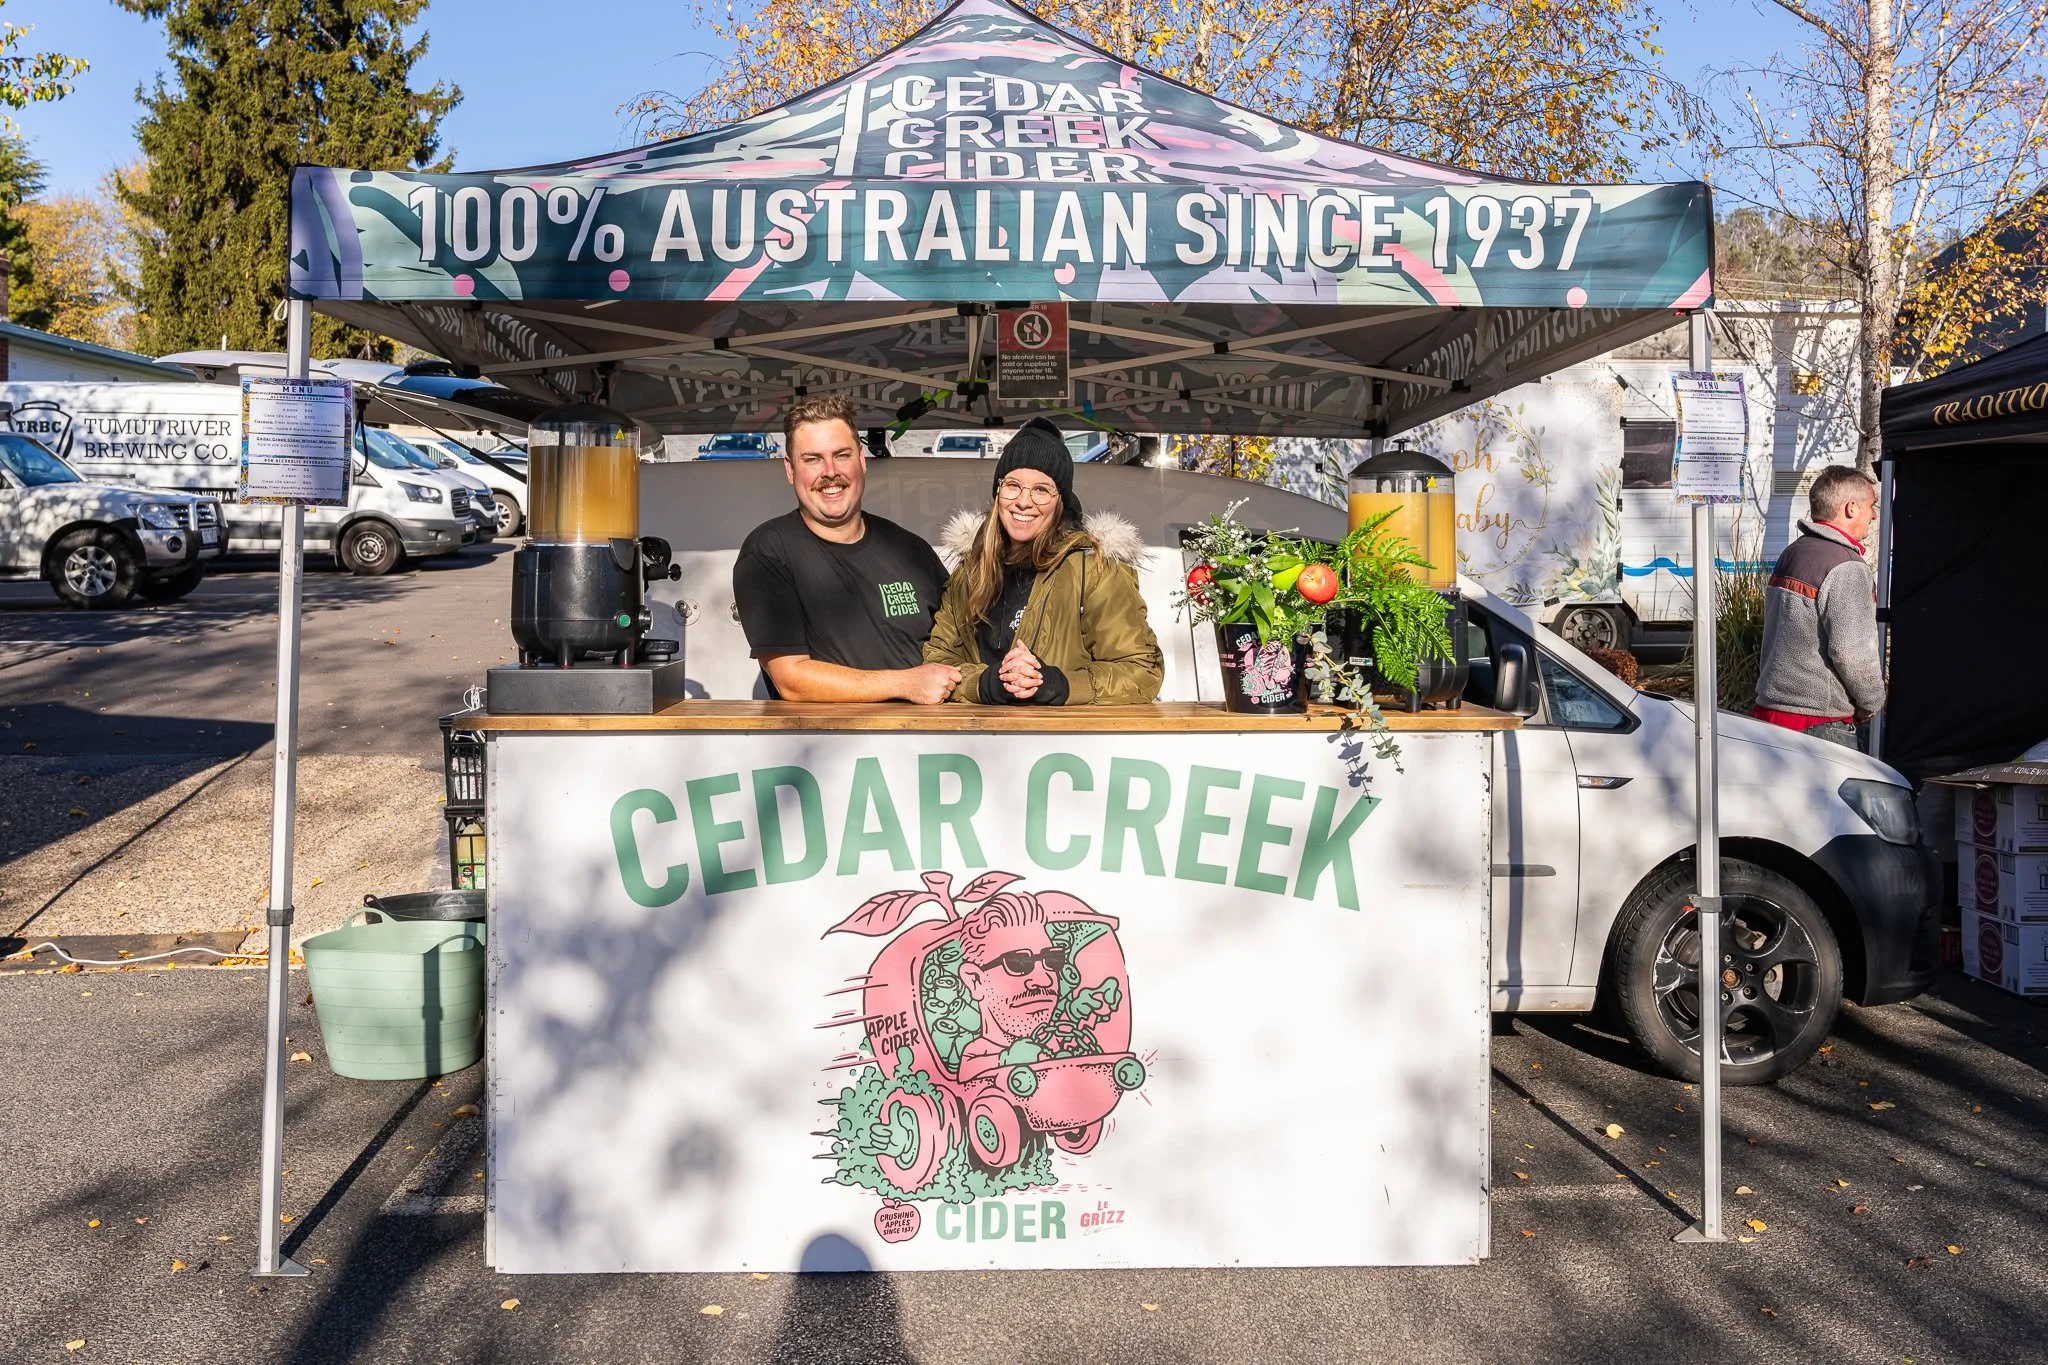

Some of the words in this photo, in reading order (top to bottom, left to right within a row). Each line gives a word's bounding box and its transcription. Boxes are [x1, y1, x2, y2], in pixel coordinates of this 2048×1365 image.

[891, 75, 1150, 113] CEDAR
[887, 115, 1169, 150] CREEK
[883, 151, 1170, 183] CIDER
[408, 186, 626, 264] 100%
[650, 187, 1147, 268] AUSTRALIAN
[1175, 192, 1398, 270] SINCE
[1426, 195, 1593, 271] 1937
[1697, 381, 1719, 389] MENU
[1931, 382, 2048, 426] TRADITIO
[16, 420, 62, 434] TRBC
[84, 418, 162, 435] TUMUT
[167, 420, 231, 436] RIVER
[84, 442, 187, 460] BREWING
[194, 444, 232, 460] CO.
[1452, 427, 1500, 473] oh
[1456, 483, 1522, 549] aby
[886, 592, 918, 605] CREEK
[890, 603, 920, 616] CIDER
[1261, 693, 1285, 704] CIDER
[609, 753, 988, 910] CEDAR
[1025, 752, 1382, 912] CREEK
[868, 1011, 908, 1038] APPLE
[882, 1028, 920, 1055] CIDER
[880, 1211, 914, 1222] CRUSHING
[1098, 1200, 1109, 1211] LE
[885, 1220, 910, 1228] APPLES
[936, 1200, 1066, 1243] CIDER
[1080, 1210, 1125, 1227] GRIZZ
